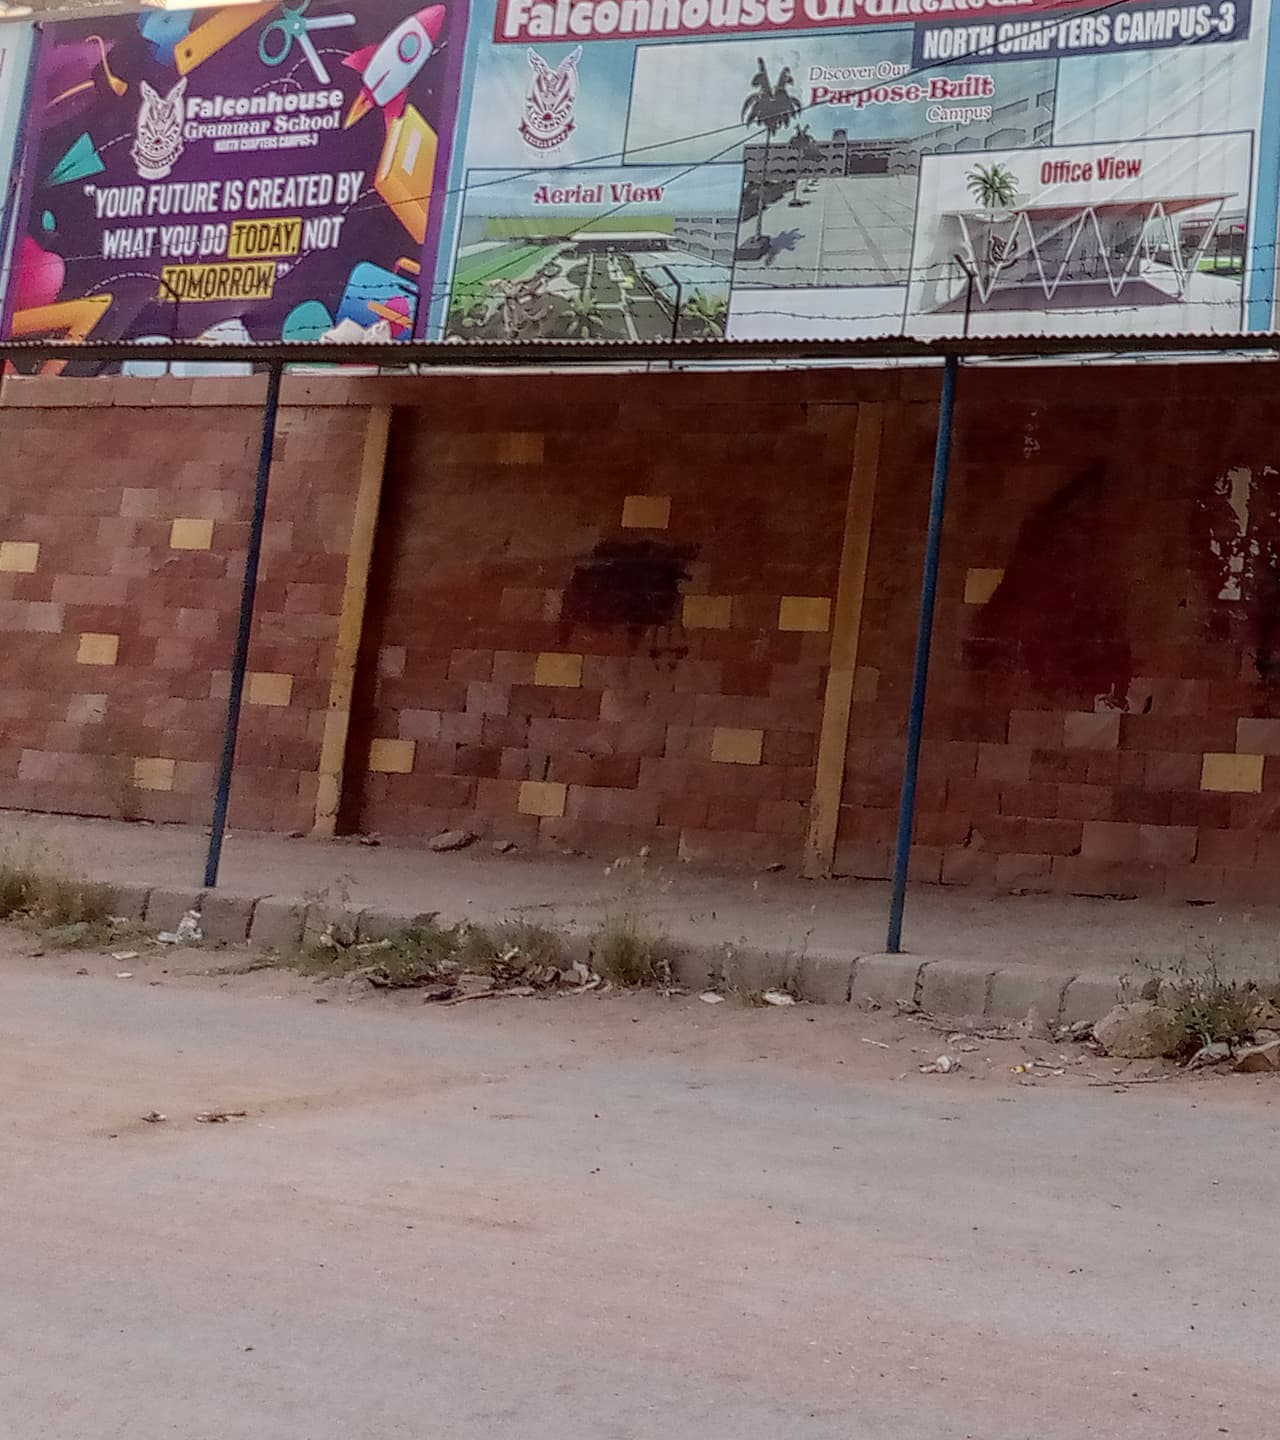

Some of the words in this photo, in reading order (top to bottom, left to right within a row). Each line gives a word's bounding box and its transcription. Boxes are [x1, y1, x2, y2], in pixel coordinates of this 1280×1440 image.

[923, 26, 995, 61] NORTH
[999, 15, 1112, 56] CHAPTERS
[1114, 1, 1236, 45] CAMPUS-3
[809, 65, 873, 82] Discover
[876, 62, 910, 78] Our
[186, 89, 344, 119] Falconhouse
[810, 74, 995, 110] Purpose-Built
[184, 120, 271, 139] Grammar
[274, 111, 341, 134] School
[926, 104, 992, 126] Campus
[1040, 161, 1094, 185] Office
[1096, 157, 1143, 179] View
[149, 181, 222, 216] FUTURE
[224, 180, 243, 211] IS
[246, 174, 334, 210] CREATED
[335, 171, 365, 205] BY
[533, 186, 604, 205] Aerial
[609, 183, 665, 203] View
[102, 227, 158, 259] WHAT
[160, 225, 199, 257] YOU
[200, 224, 228, 255] DO
[302, 216, 345, 250] NOT
